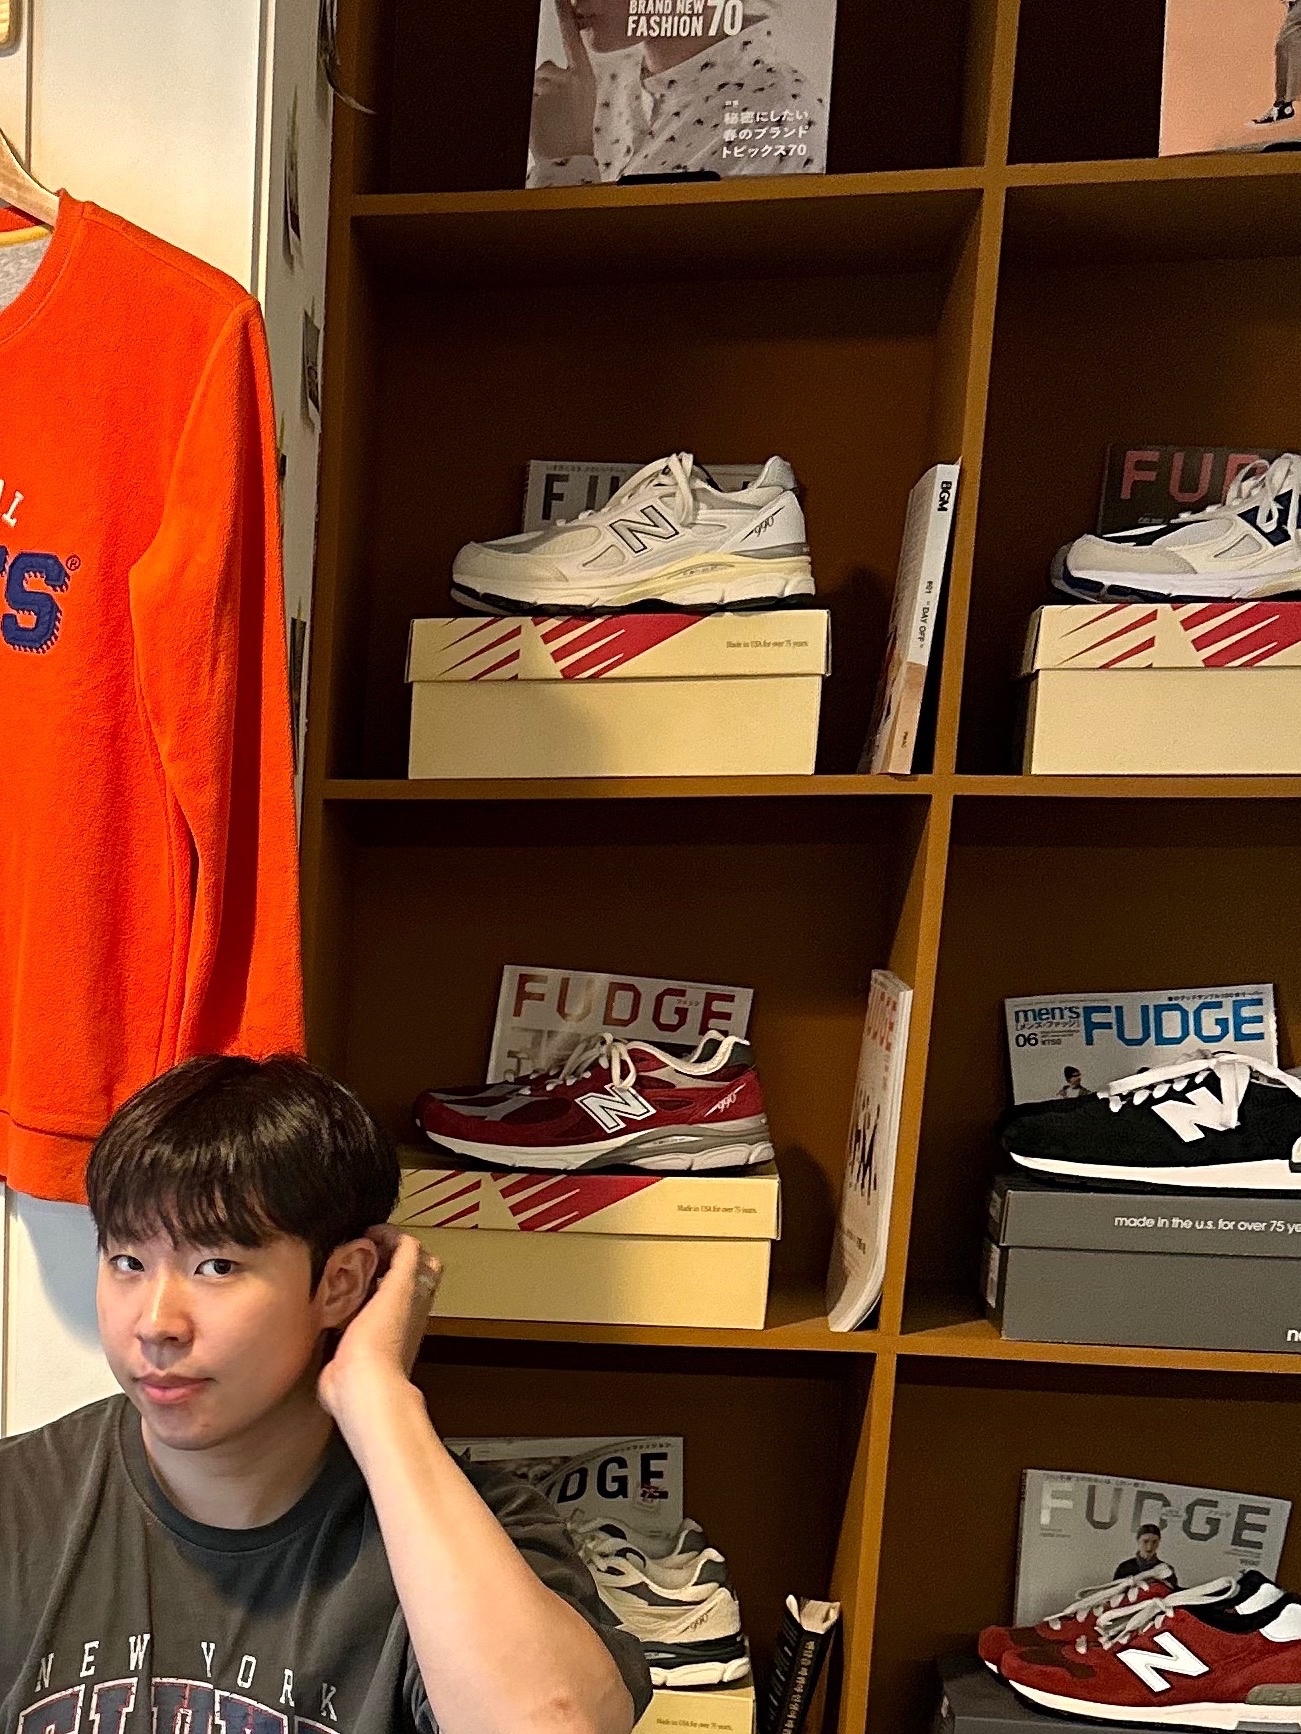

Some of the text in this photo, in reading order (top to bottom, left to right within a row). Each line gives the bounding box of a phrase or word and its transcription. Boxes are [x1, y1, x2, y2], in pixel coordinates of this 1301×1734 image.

[627, 15, 703, 37] FASHION
[707, 0, 744, 36] 70
[722, 144, 807, 158] トピックス70
[937, 480, 953, 512] BGM
[609, 504, 680, 554] N
[512, 973, 736, 1035] FUDGE
[1014, 999, 1265, 1046] men's FUDGE
[1015, 1033, 1038, 1047] 06
[575, 1084, 656, 1134] N
[716, 1092, 738, 1113] 990
[1114, 1216, 1155, 1228] made
[1157, 1216, 1169, 1228] in
[1171, 1216, 1192, 1229] the
[1195, 1219, 1216, 1230] u.s.
[1218, 1218, 1235, 1230] for
[1237, 1220, 1267, 1232] over
[1269, 1220, 1285, 1232] 75
[1040, 1482, 1271, 1550] FUDGE
[35, 1633, 338, 1721] NEW YORK
[1116, 1631, 1210, 1692] N
